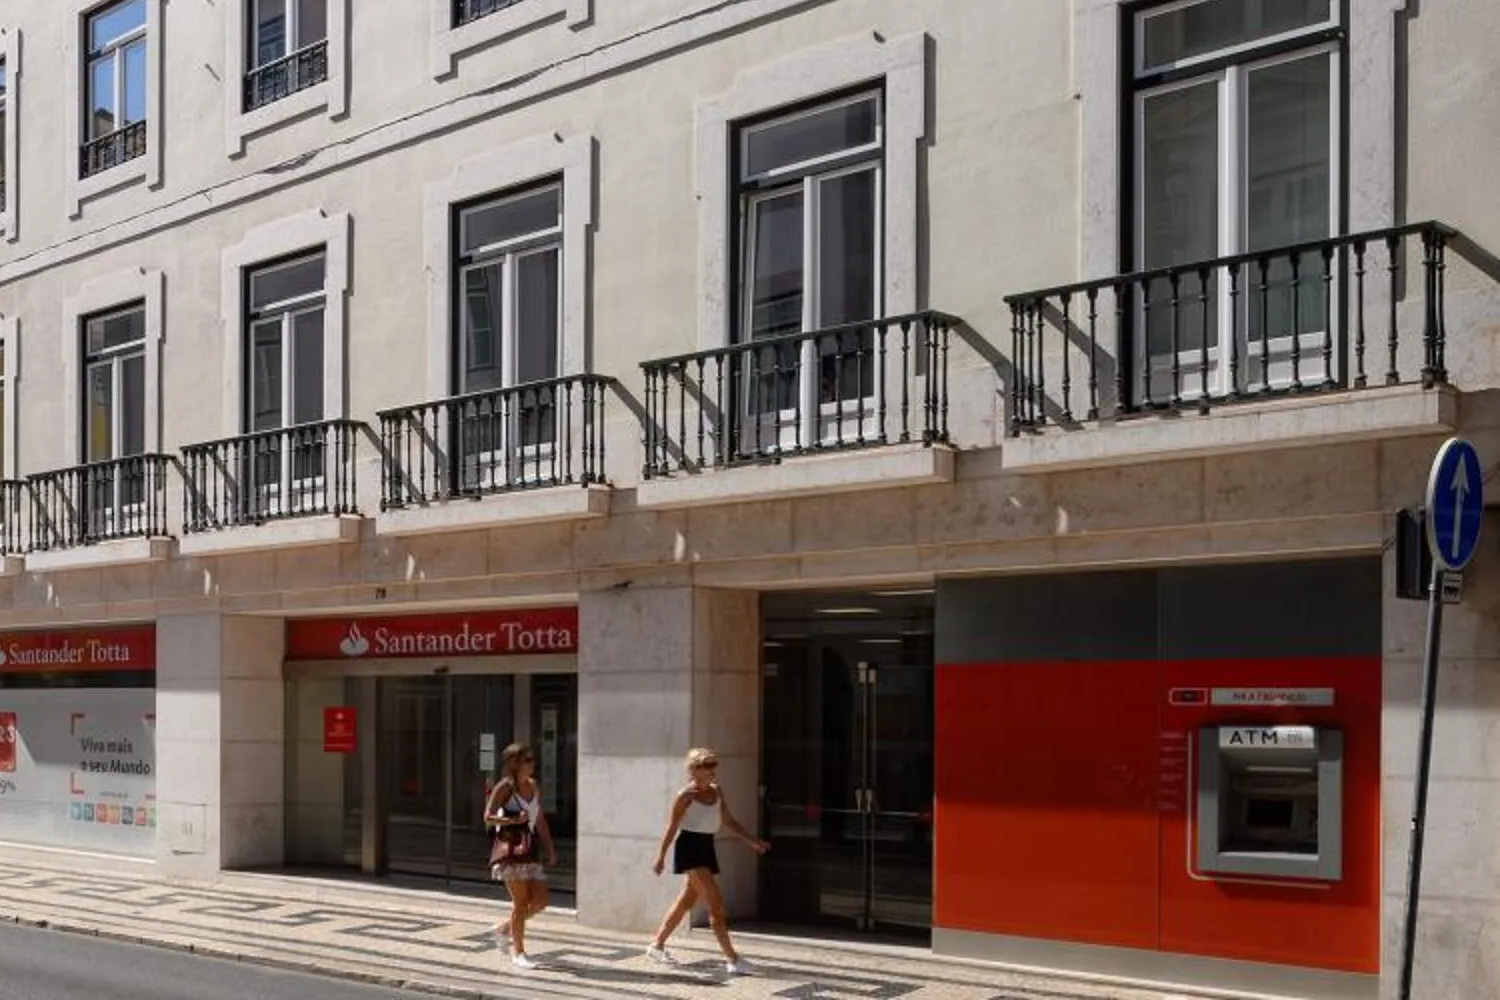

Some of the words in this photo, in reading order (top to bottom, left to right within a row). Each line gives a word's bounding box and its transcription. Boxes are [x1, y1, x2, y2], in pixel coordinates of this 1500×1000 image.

[375, 622, 496, 653] Santander
[500, 621, 573, 649] Totta
[9, 640, 85, 665] Santander
[86, 639, 132, 662] Totta
[81, 738, 104, 753] Viva
[107, 737, 133, 754] mais
[1229, 730, 1278, 745] ATM
[89, 761, 109, 773] seu
[109, 759, 151, 775] Mundo
